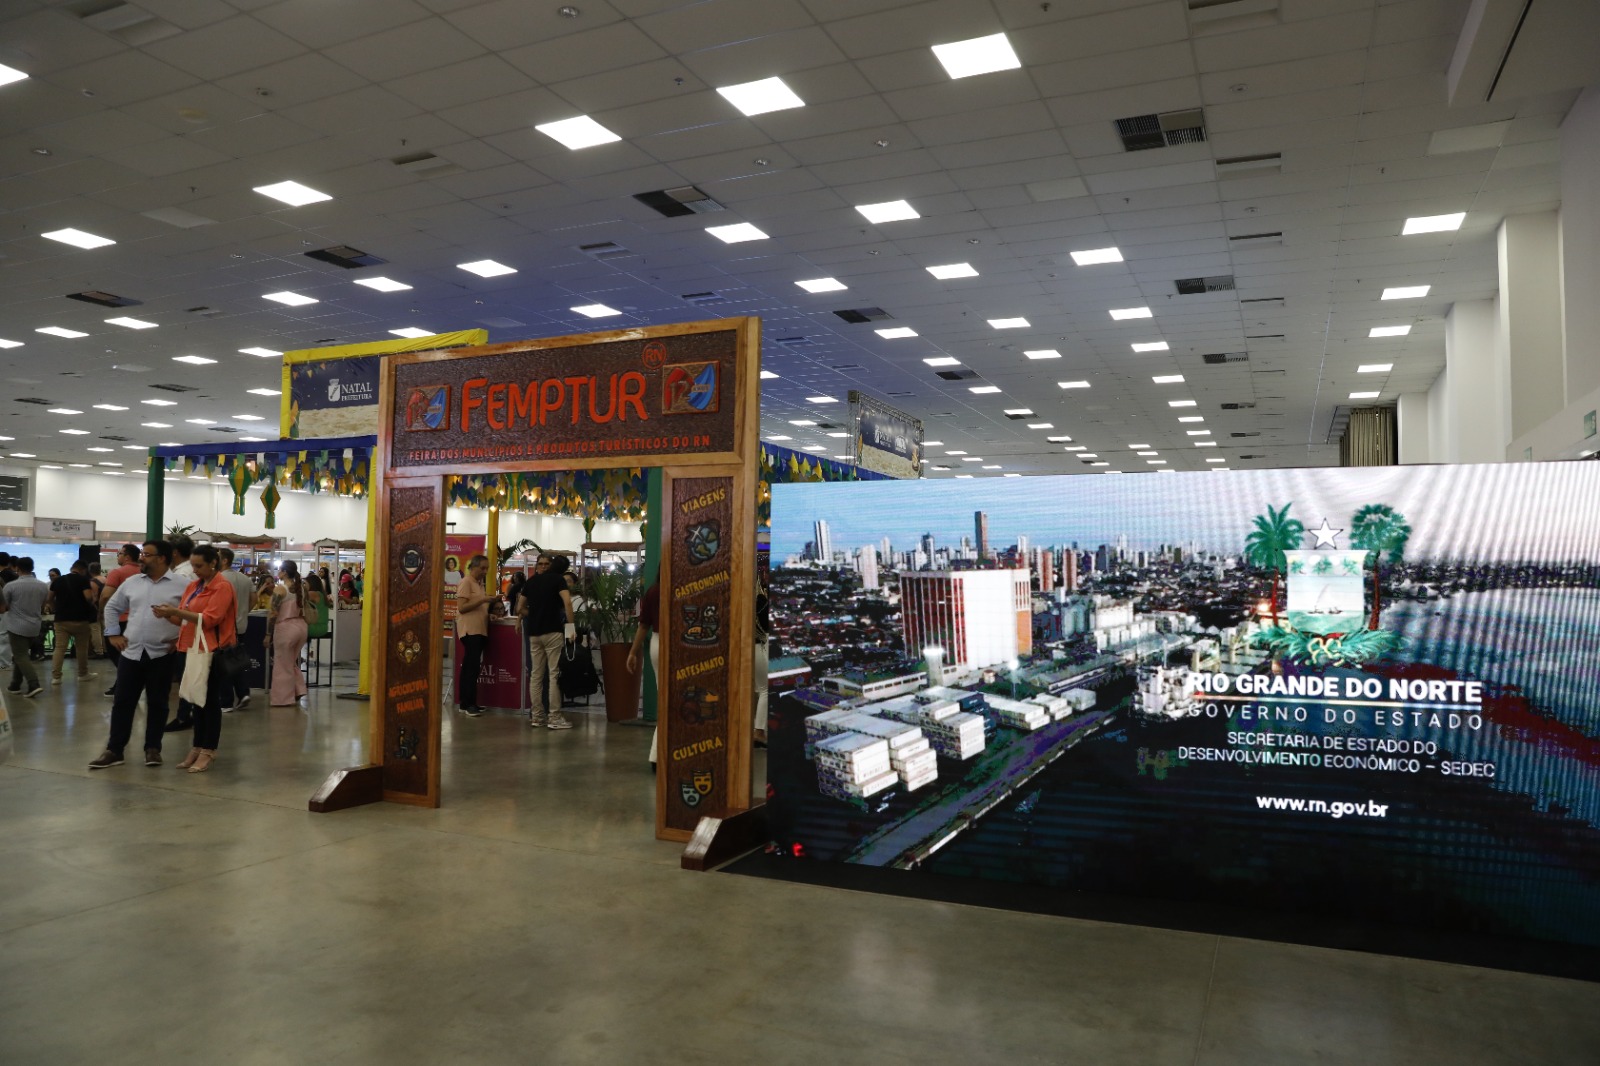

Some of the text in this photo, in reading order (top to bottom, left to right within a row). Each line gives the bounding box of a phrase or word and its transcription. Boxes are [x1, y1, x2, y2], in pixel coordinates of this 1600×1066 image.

[341, 382, 373, 394] NATAL
[460, 371, 648, 432] FEMPTUR
[409, 435, 710, 460] FEIRA DOS MUNICÍPIOS E PRODUTOS TURÍSTICOS DO RN
[681, 488, 726, 514] VIAGENS
[675, 570, 730, 598] GASTRONOMIA
[675, 655, 725, 681] ARTESANATO
[1187, 673, 1482, 703] RIO GRANDE DO NORTE
[1188, 703, 1483, 730] GOVERNO DO ESTADO
[672, 736, 723, 761] CULTURA
[1227, 731, 1437, 756] SECRETARIA DE ESTADO DO
[1178, 746, 1321, 768] DESENVOLVIMENTO
[1324, 754, 1420, 773] ECONÔMICO
[1441, 761, 1496, 778] SEDEC
[1256, 794, 1389, 819] www.rn.gov.br
